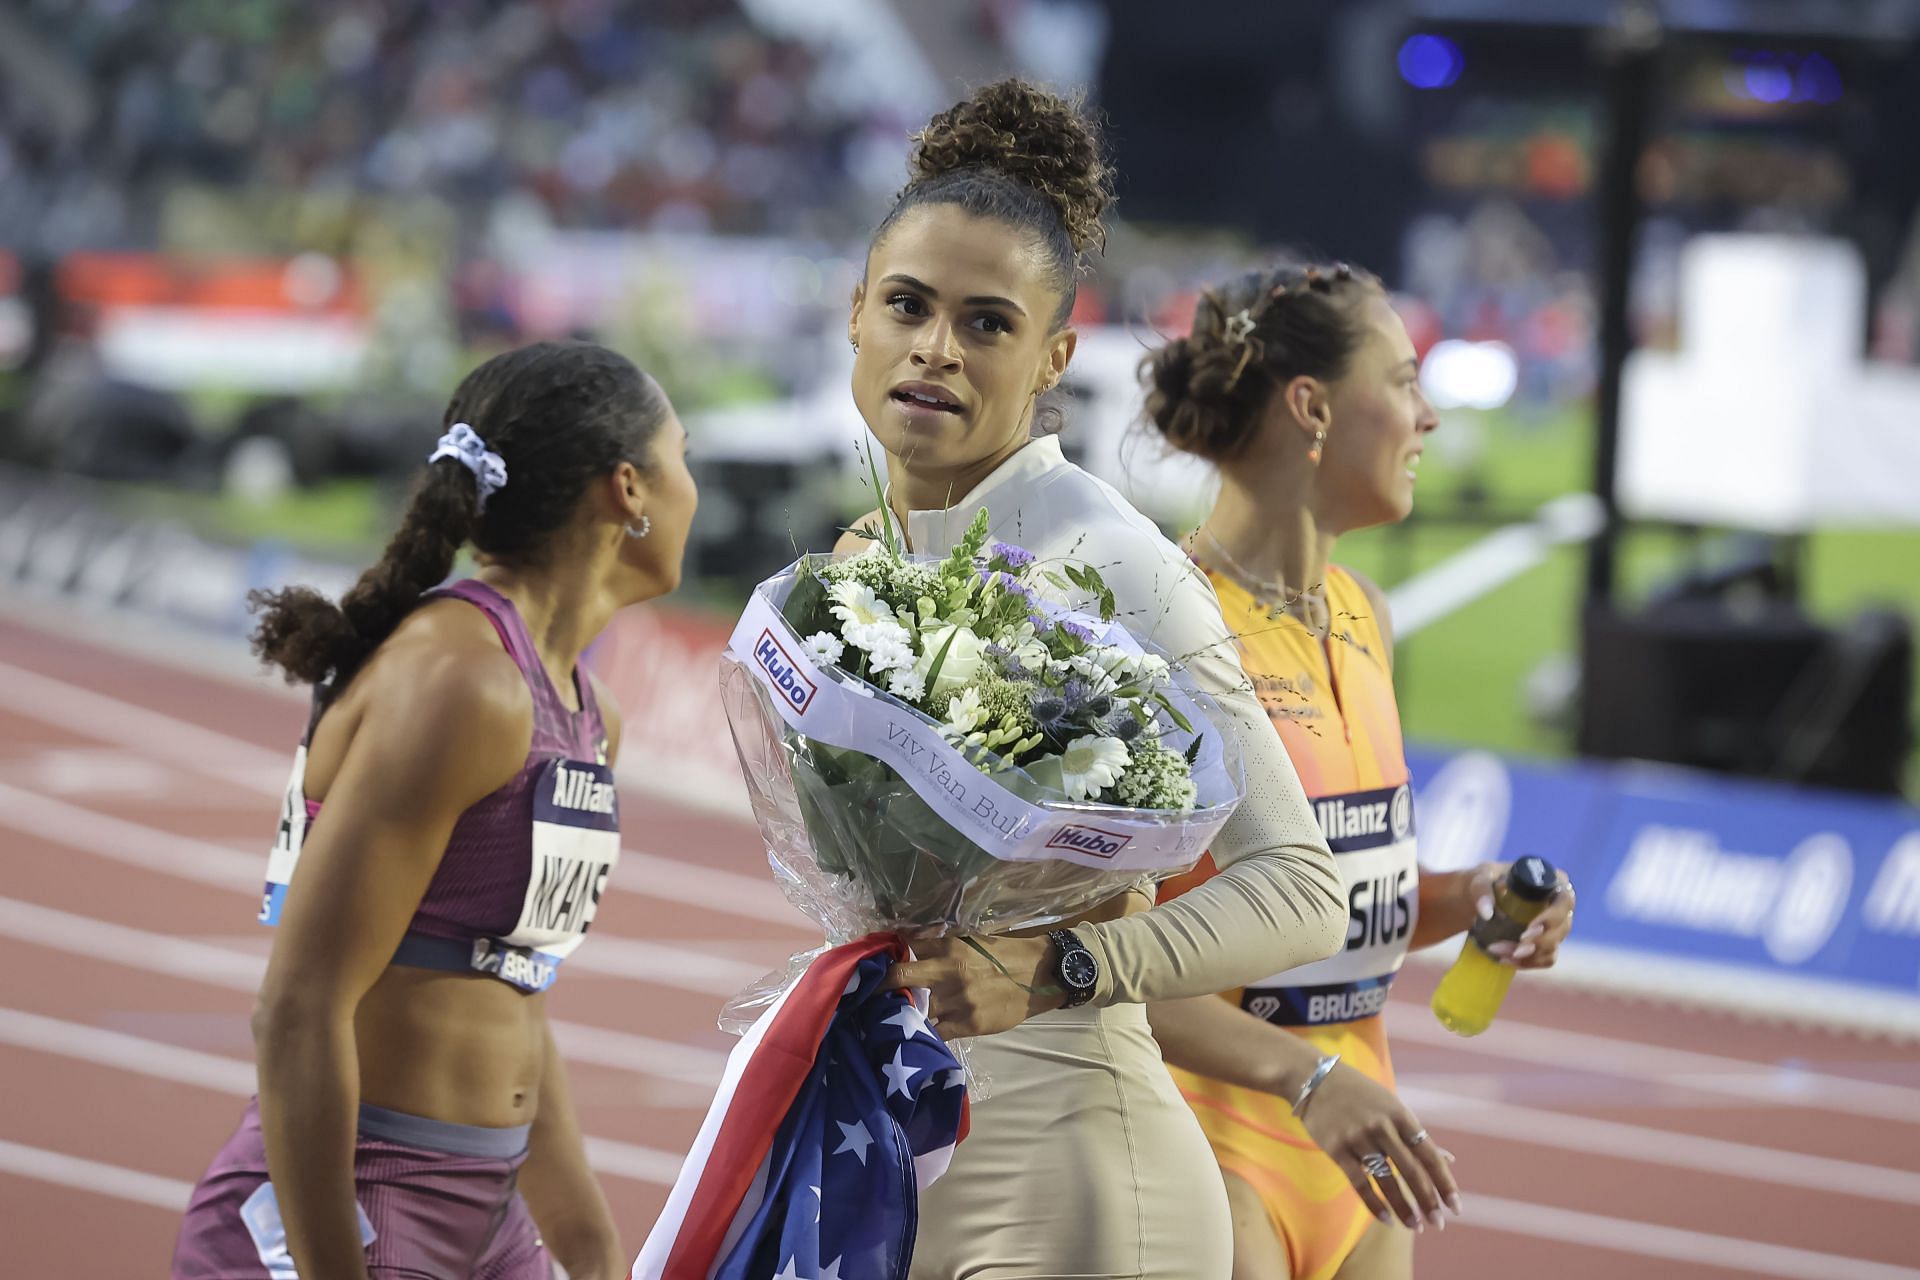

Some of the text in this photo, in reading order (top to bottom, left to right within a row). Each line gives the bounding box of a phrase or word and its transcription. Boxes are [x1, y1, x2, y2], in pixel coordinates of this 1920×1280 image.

[757, 639, 806, 704] Hubo
[887, 722, 925, 755] Viv
[928, 752, 967, 802] Van
[1053, 828, 1119, 854] Hubo
[1311, 798, 1388, 840] llianz
